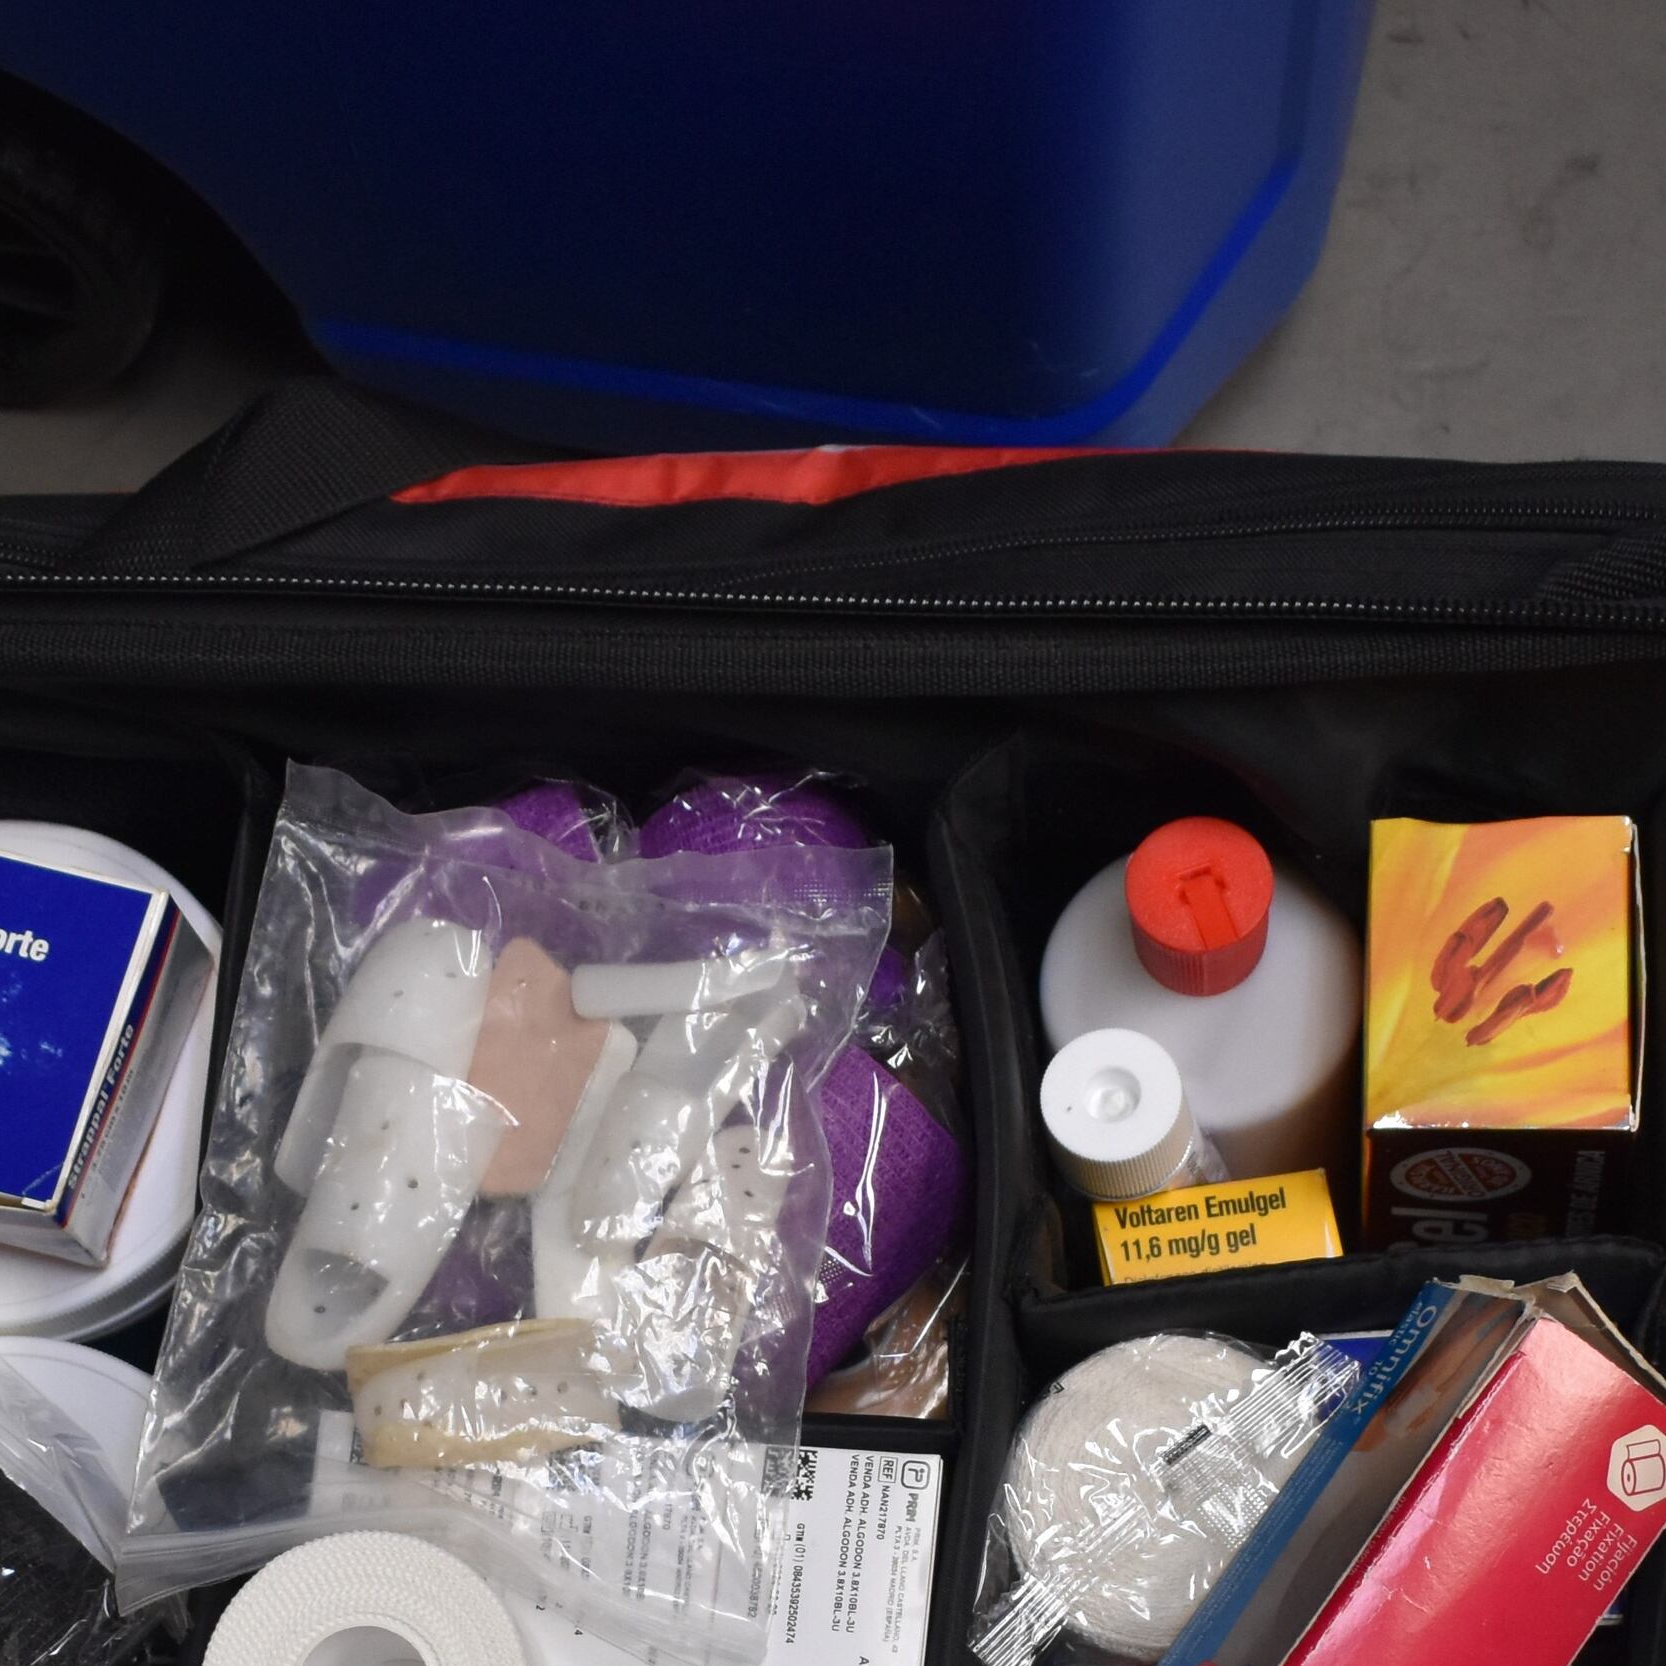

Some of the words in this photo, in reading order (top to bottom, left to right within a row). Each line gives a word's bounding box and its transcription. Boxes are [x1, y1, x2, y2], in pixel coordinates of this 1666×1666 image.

[107, 1025, 134, 1085] Forte
[1114, 1202, 1199, 1230] Voltaren
[1204, 1186, 1287, 1219] Emulgel
[1390, 1206, 1490, 1250] el
[1120, 1236, 1163, 1262] 11,6
[1167, 1228, 1220, 1258] mg/g
[1226, 1223, 1257, 1253] gel
[1351, 1305, 1438, 1415] Omnifix
[862, 1455, 875, 1490] VENDA
[858, 1492, 870, 1516] ADH.
[875, 1485, 890, 1541] NAN217870
[904, 1492, 919, 1522] PRIM
[852, 1518, 867, 1569] ALGODON
[1535, 1498, 1597, 1575] Στερέωση
[1566, 1511, 1611, 1567] Fixação
[1578, 1523, 1625, 1581] Fixation
[1593, 1534, 1638, 1591] Fijación
[785, 1565, 803, 1644] 08435392502474
